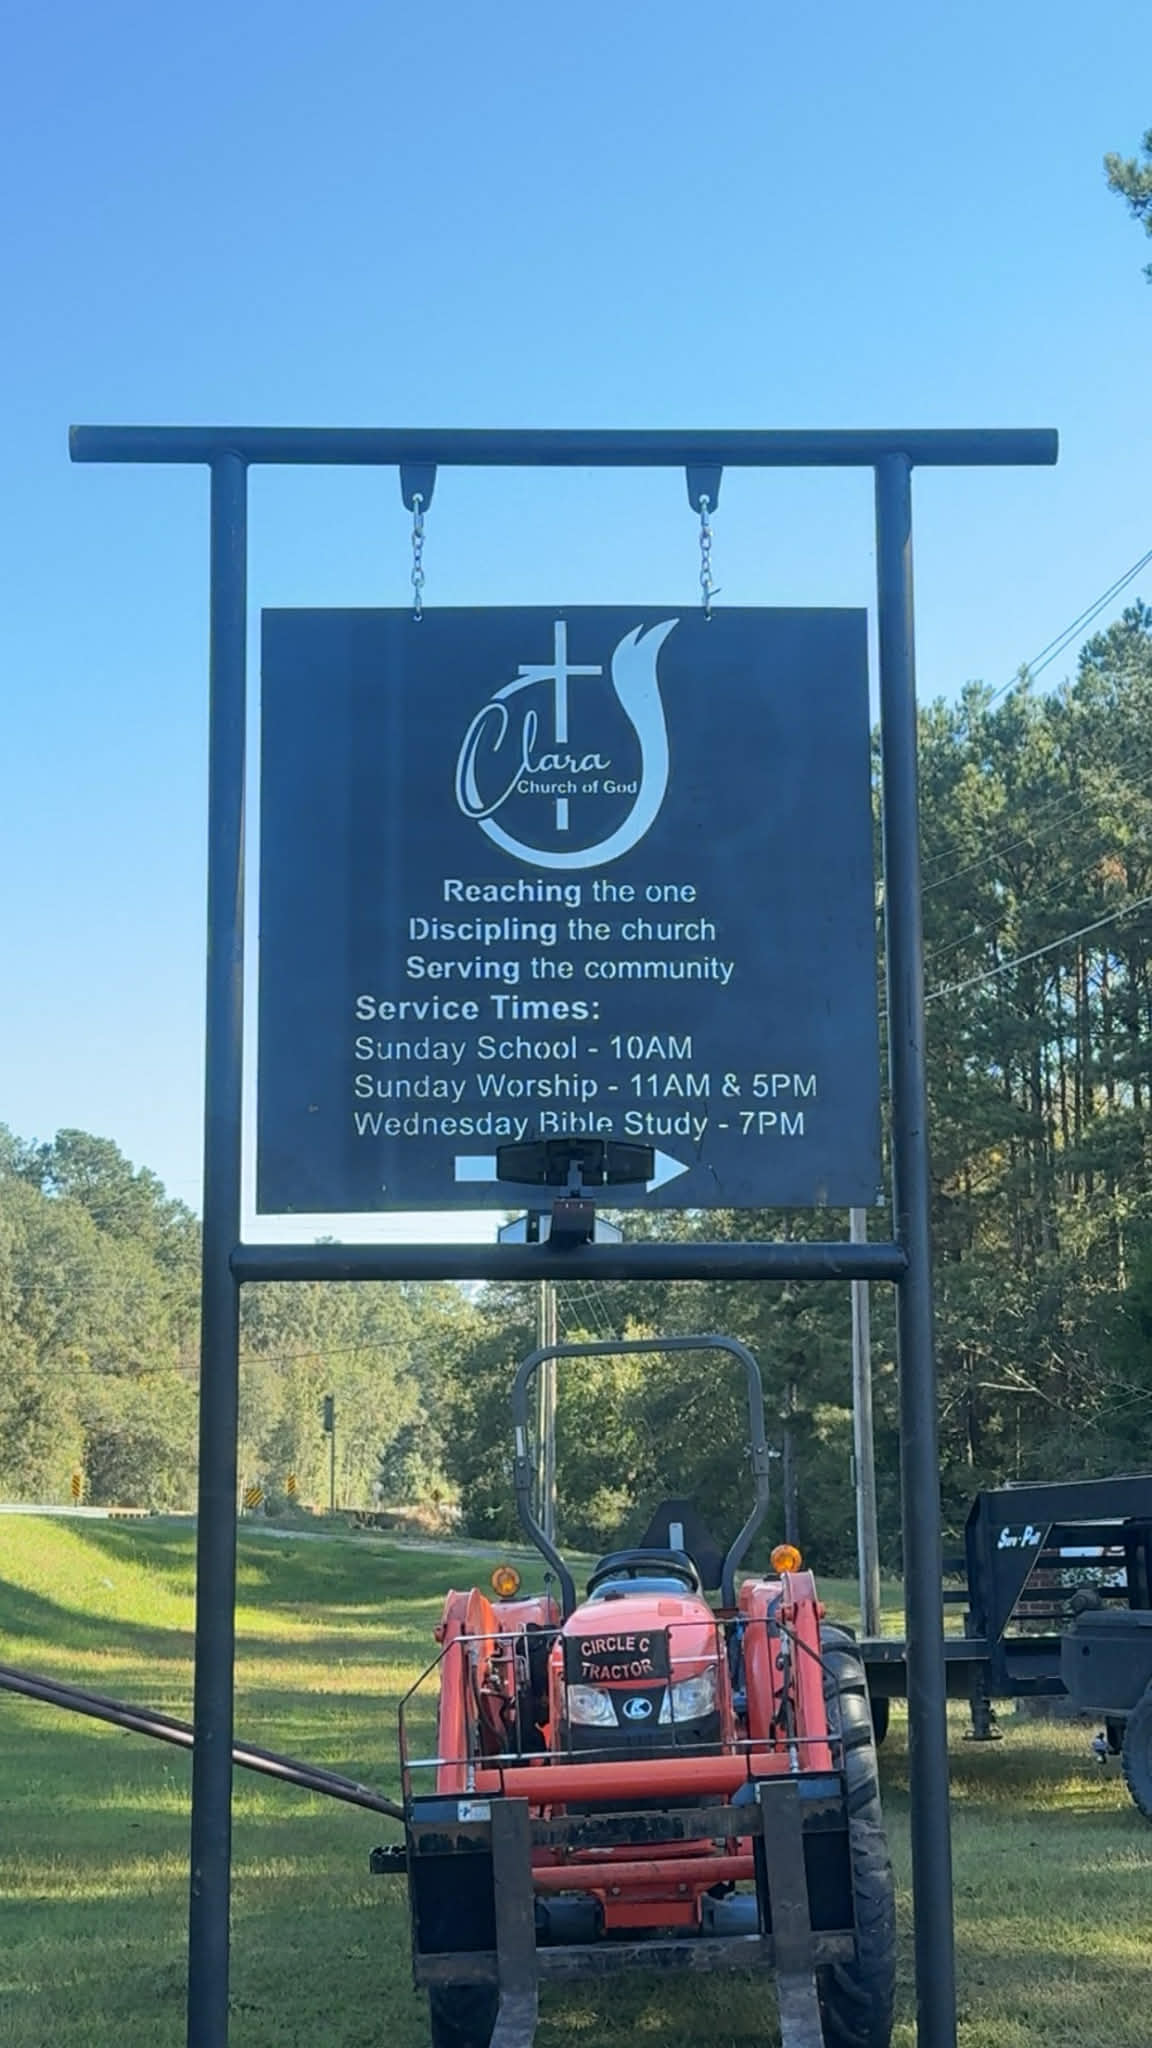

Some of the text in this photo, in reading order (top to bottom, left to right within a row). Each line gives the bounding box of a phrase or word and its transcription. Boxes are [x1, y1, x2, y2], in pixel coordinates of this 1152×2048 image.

[456, 702, 611, 818] Clara
[517, 779, 638, 794] Church of God
[444, 879, 696, 908] Reaching the one
[410, 917, 715, 946] Discipling the church
[407, 956, 734, 985] Serving the community
[356, 995, 599, 1020] Service Times:
[355, 1036, 466, 1065] Sunday
[478, 1036, 576, 1059] School
[611, 1036, 692, 1059] 10AM
[355, 1074, 466, 1103] Sunday
[477, 1073, 598, 1103] Worship
[631, 1073, 710, 1096] 11AM
[722, 1073, 741, 1097] &
[753, 1074, 816, 1098] 5PM
[354, 1112, 528, 1141] Wednesday
[540, 1111, 613, 1132] Bible
[624, 1111, 708, 1141] Study
[739, 1111, 804, 1136] 7PM
[581, 1636, 650, 1656] CIRCLE C
[581, 1659, 654, 1679] TRACTOR
